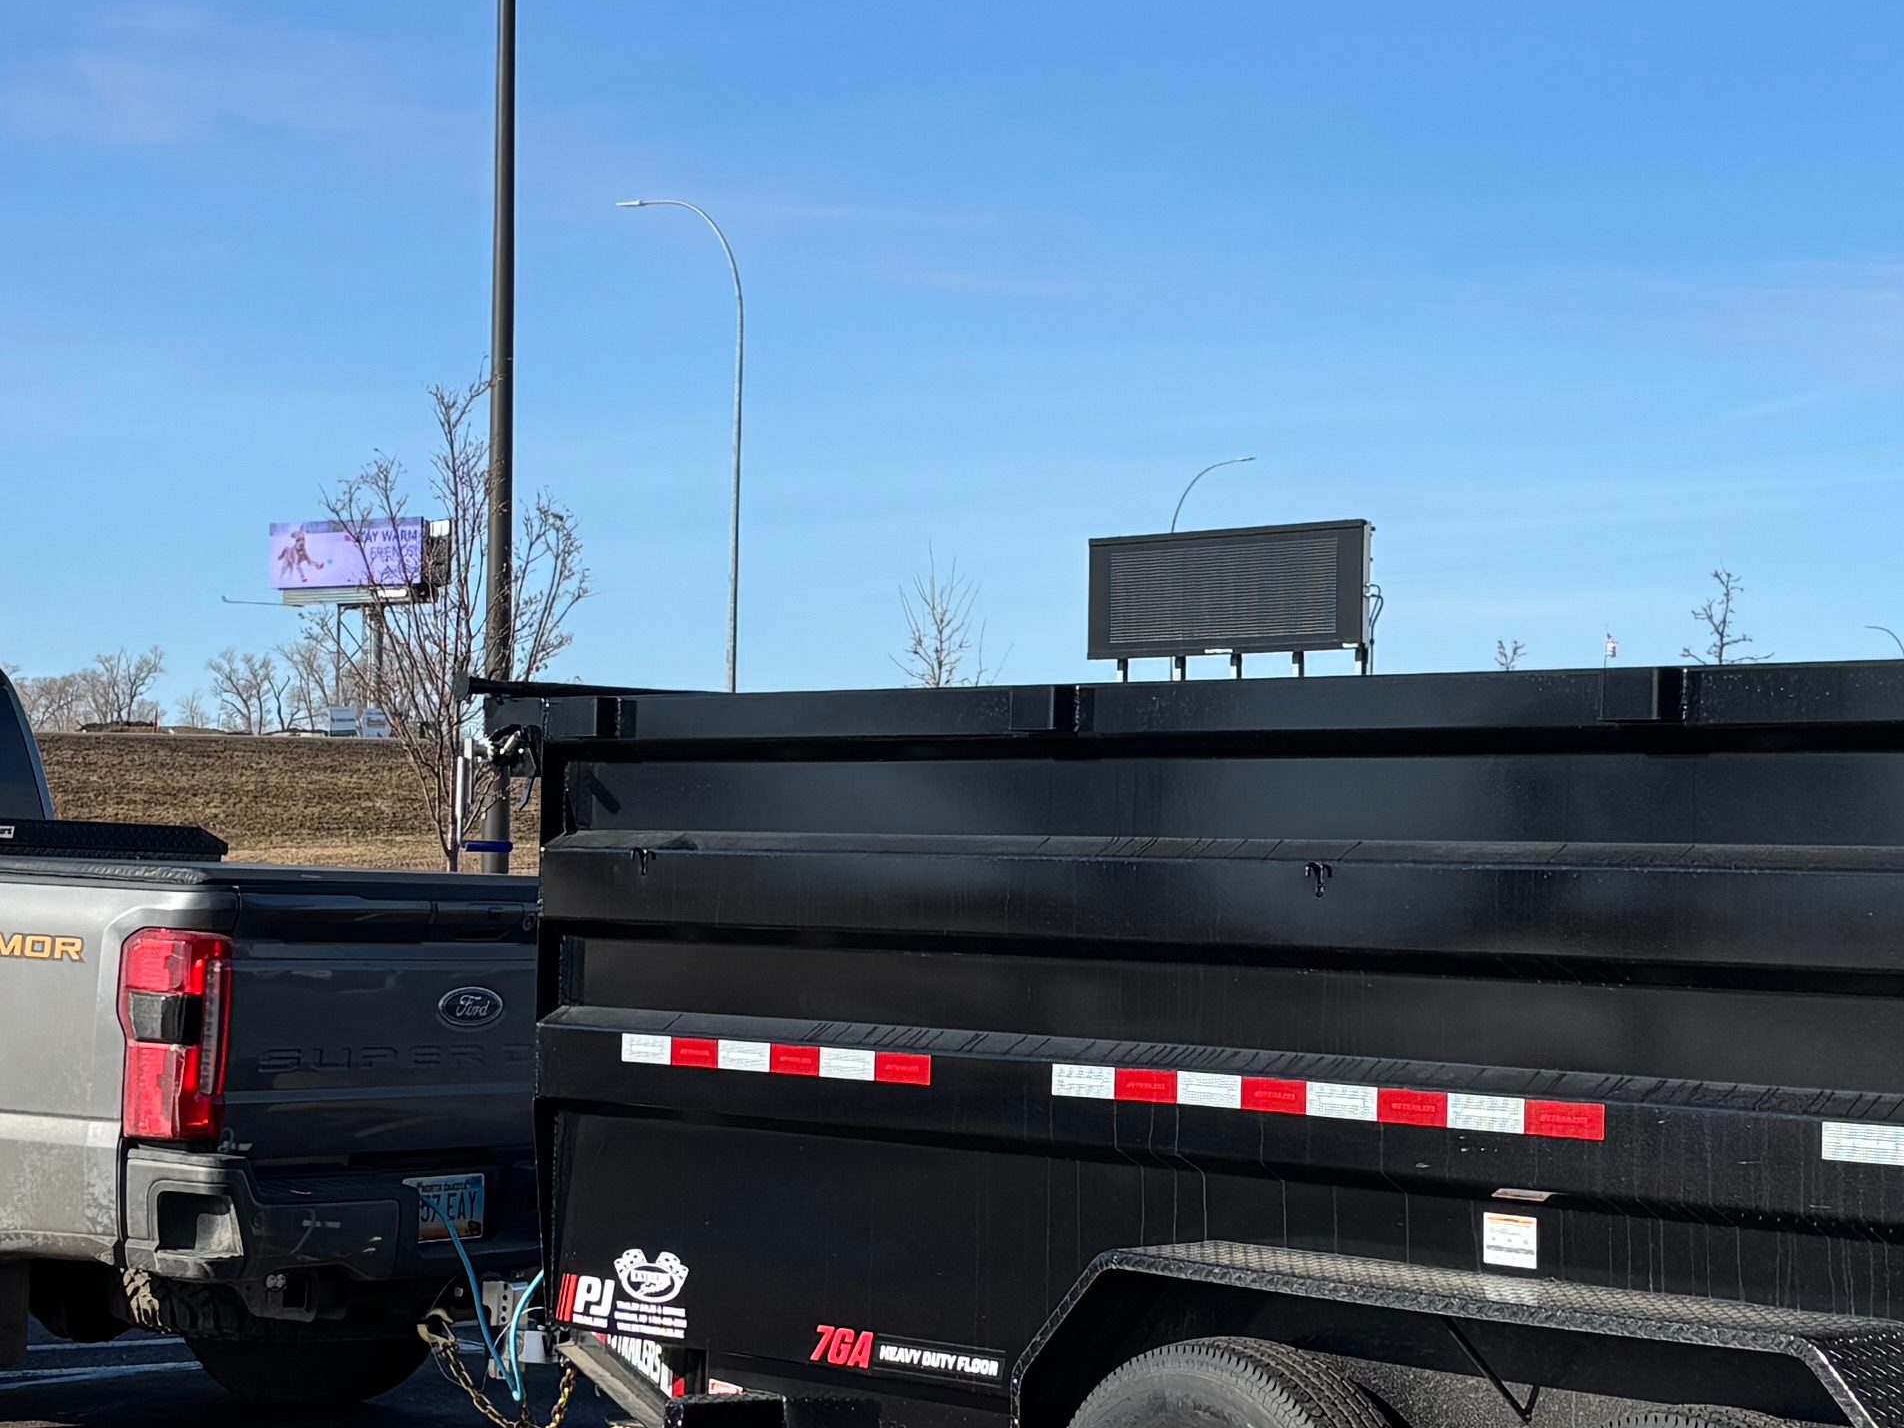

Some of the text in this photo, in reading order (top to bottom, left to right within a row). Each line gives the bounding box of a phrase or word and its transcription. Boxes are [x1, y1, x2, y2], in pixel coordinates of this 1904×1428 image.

[456, 994, 491, 1017] Ford
[446, 1191, 477, 1220] EAY
[573, 1275, 616, 1317] PJ
[810, 1324, 874, 1369] 7GA
[879, 1344, 999, 1377] HEAVY DUTY FLOOR
